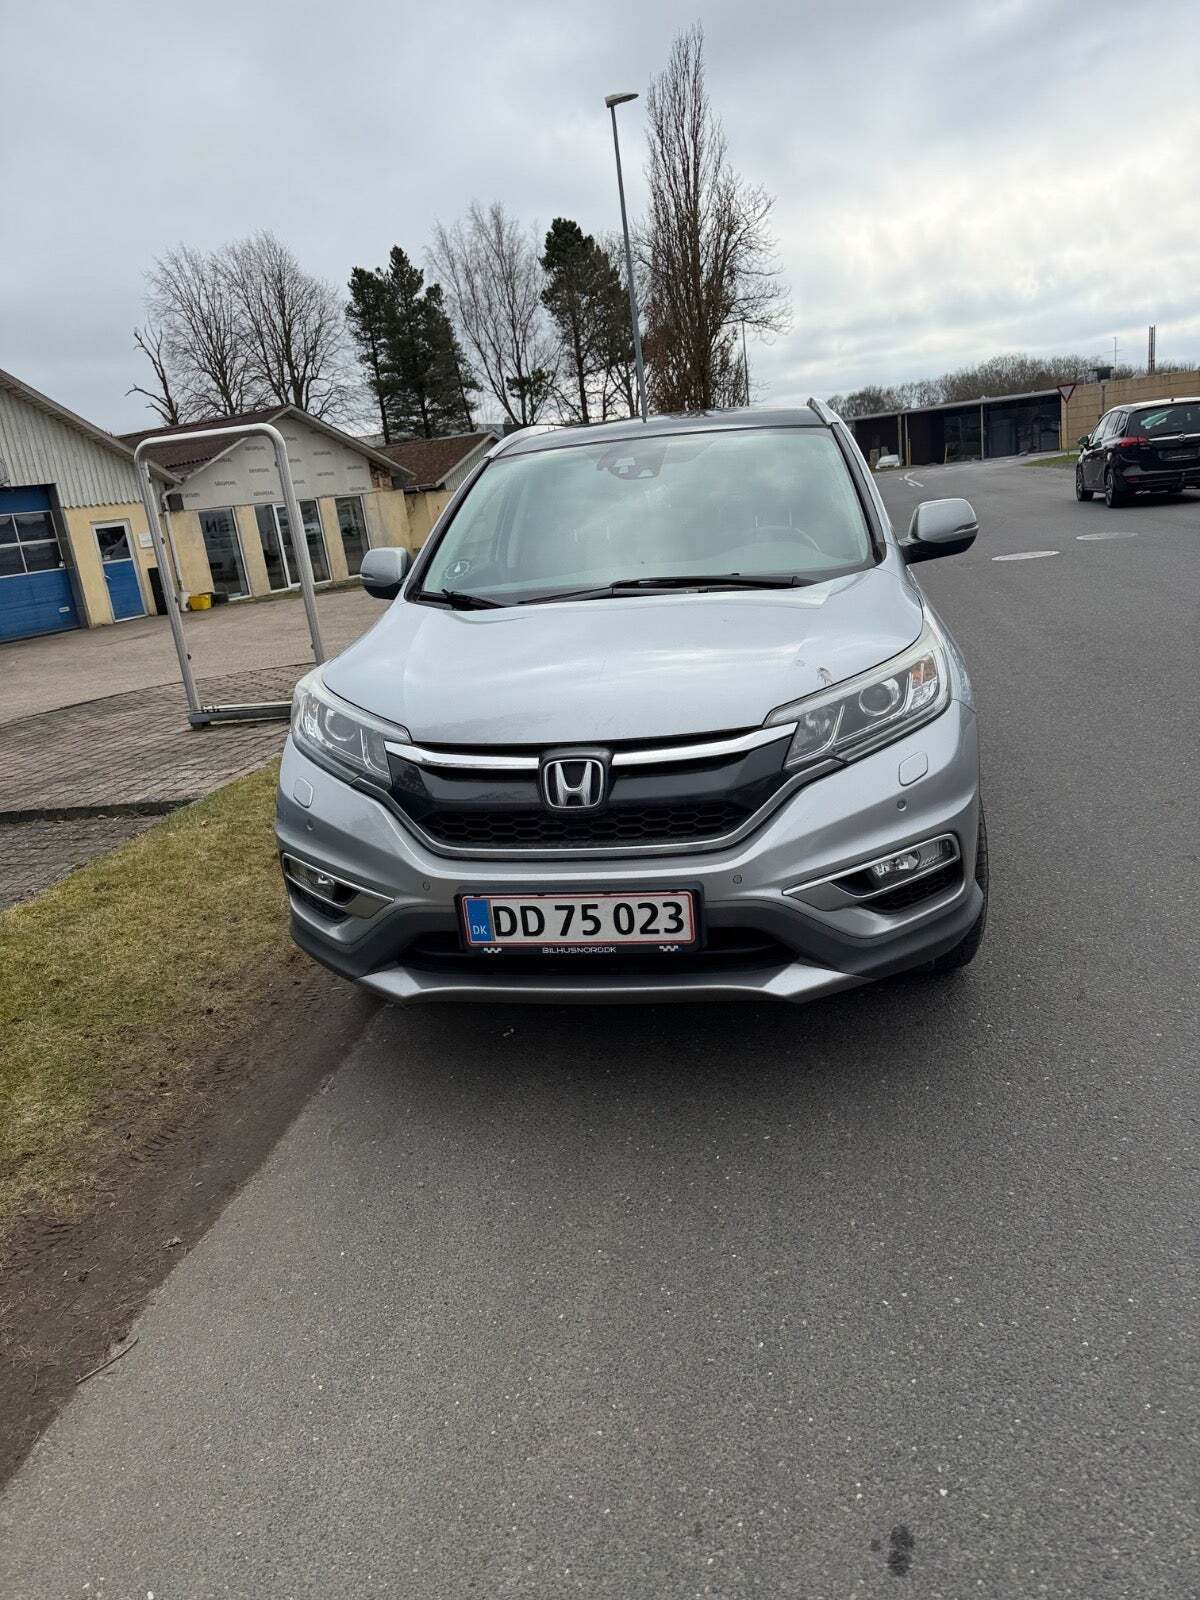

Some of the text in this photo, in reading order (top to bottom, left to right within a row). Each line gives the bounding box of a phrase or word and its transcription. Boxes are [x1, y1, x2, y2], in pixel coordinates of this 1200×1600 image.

[472, 925, 488, 935] DK
[492, 901, 684, 937] DD 75 023
